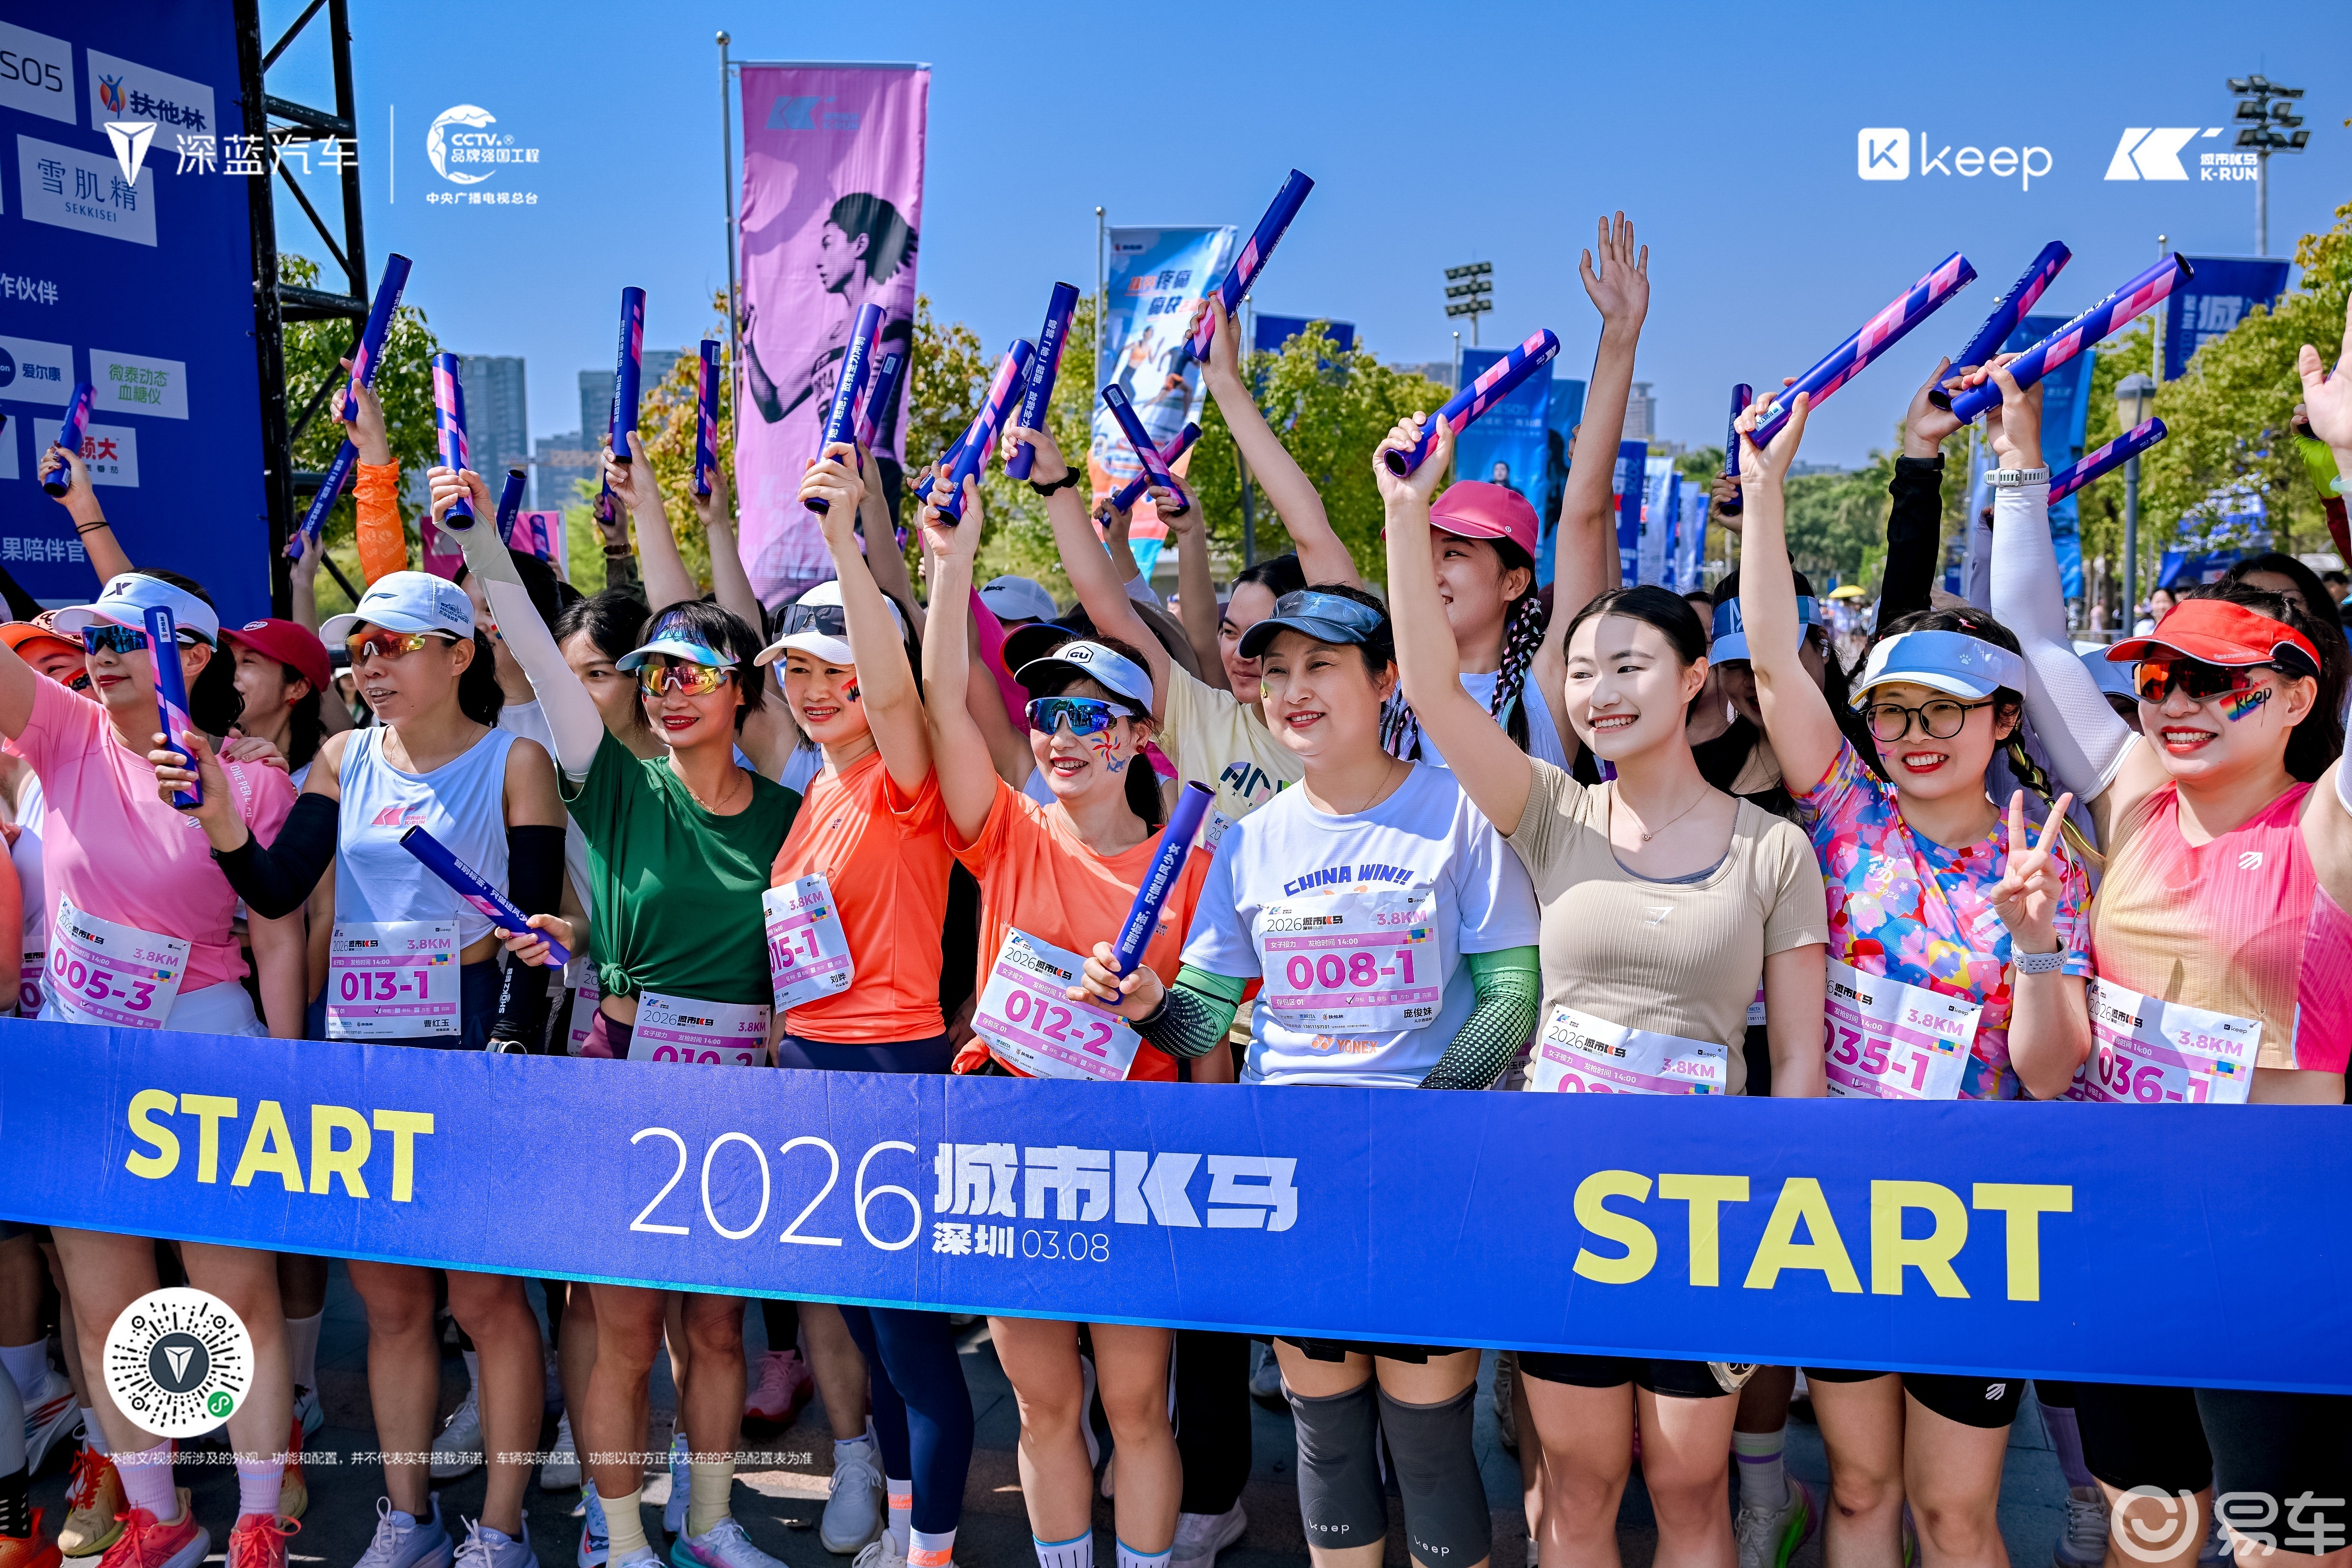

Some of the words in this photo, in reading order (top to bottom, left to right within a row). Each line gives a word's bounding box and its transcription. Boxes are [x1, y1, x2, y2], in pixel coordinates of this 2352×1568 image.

[129, 90, 207, 132] 扶他林
[37, 158, 138, 212] 雪肌精
[65, 201, 117, 223] SEKKISEI
[22, 363, 62, 382] 爱尔康
[109, 364, 168, 388] 微泰动态
[118, 385, 161, 405] 血糖仪
[1756, 410, 1774, 427] BRITA
[2, 537, 85, 563] 果陪伴官
[2234, 687, 2272, 725] keep
[230, 765, 242, 783] ONE
[237, 779, 252, 796] PER
[1283, 865, 1352, 897] CHINA
[1357, 863, 1415, 886] WIN!!
[789, 890, 825, 911] 3.8KM
[1875, 886, 1900, 901] 2024
[1267, 918, 1302, 932] 2026
[1302, 915, 1343, 926] 城市K马
[1376, 910, 1427, 926] 3.8KM
[333, 940, 348, 952] 2026
[407, 938, 451, 950] 3.8KM
[768, 928, 820, 975] 015-1
[91, 954, 110, 966] 14:00
[133, 948, 179, 967] 3.8KM
[1004, 947, 1037, 969] 2026
[1035, 959, 1074, 981] 城市K马
[54, 947, 157, 1011] 005-3
[1286, 949, 1415, 991] 008-1
[341, 970, 428, 1001] 013-1
[1002, 967, 1025, 982] 女子接力
[1032, 981, 1057, 996] 发枪时间
[499, 983, 510, 1013] SHOKZ
[1834, 982, 1873, 1005] 城市K马
[1841, 994, 1851, 1003] 03.08
[643, 1010, 677, 1026] 2026
[678, 1015, 714, 1027] 城市K马
[1403, 1006, 1432, 1019] 庞俊妹
[1834, 1006, 1859, 1024] 发枪时间
[1860, 1018, 1883, 1031] 14:00
[1907, 1008, 1964, 1036] 3.8KM
[1954, 1006, 1969, 1016] keep
[2089, 998, 2112, 1021] 2026
[2111, 1007, 2144, 1029] 城市K马
[423, 1019, 450, 1028] 曹红玉
[737, 1021, 766, 1032] 3.8KM
[982, 1017, 999, 1030] 存包区
[1000, 1025, 1007, 1033] 01
[1004, 990, 1113, 1058] 012-2
[2230, 1025, 2247, 1034] keep
[642, 1029, 668, 1038] 女子接力
[678, 1034, 702, 1043] 发枪时间
[1000, 1040, 1011, 1049] BRITA
[1336, 1038, 1378, 1054] YONEX
[1548, 1026, 1585, 1049] 2026
[1584, 1037, 1627, 1058] 城市K马
[2111, 1034, 2132, 1049] 发枪时间
[2133, 1043, 2153, 1056] 14:00
[2178, 1030, 2244, 1057] 3.8KM
[996, 1049, 1019, 1063] 13911157101
[1021, 1051, 1034, 1060] 扶他林
[1703, 1050, 1716, 1058] keep
[1547, 1049, 1573, 1064] 女子接力
[1584, 1062, 1612, 1078] 发枪时间
[1614, 1072, 1637, 1084] 14:00
[1661, 1057, 1715, 1078] 3.8KM
[2099, 1047, 2209, 1103] 036-1
[2087, 1085, 2098, 1098] 存包区
[124, 1089, 434, 1203] START
[629, 1126, 923, 1252] 2026
[933, 1142, 1298, 1232] 城市K马
[931, 1221, 1014, 1259] 深圳
[1021, 1226, 1110, 1263] 03.08
[1572, 1169, 2073, 1302] START
[483, 1532, 498, 1541] ANTA
[1308, 1519, 1350, 1535] keep
[1414, 1535, 1450, 1557] keep
